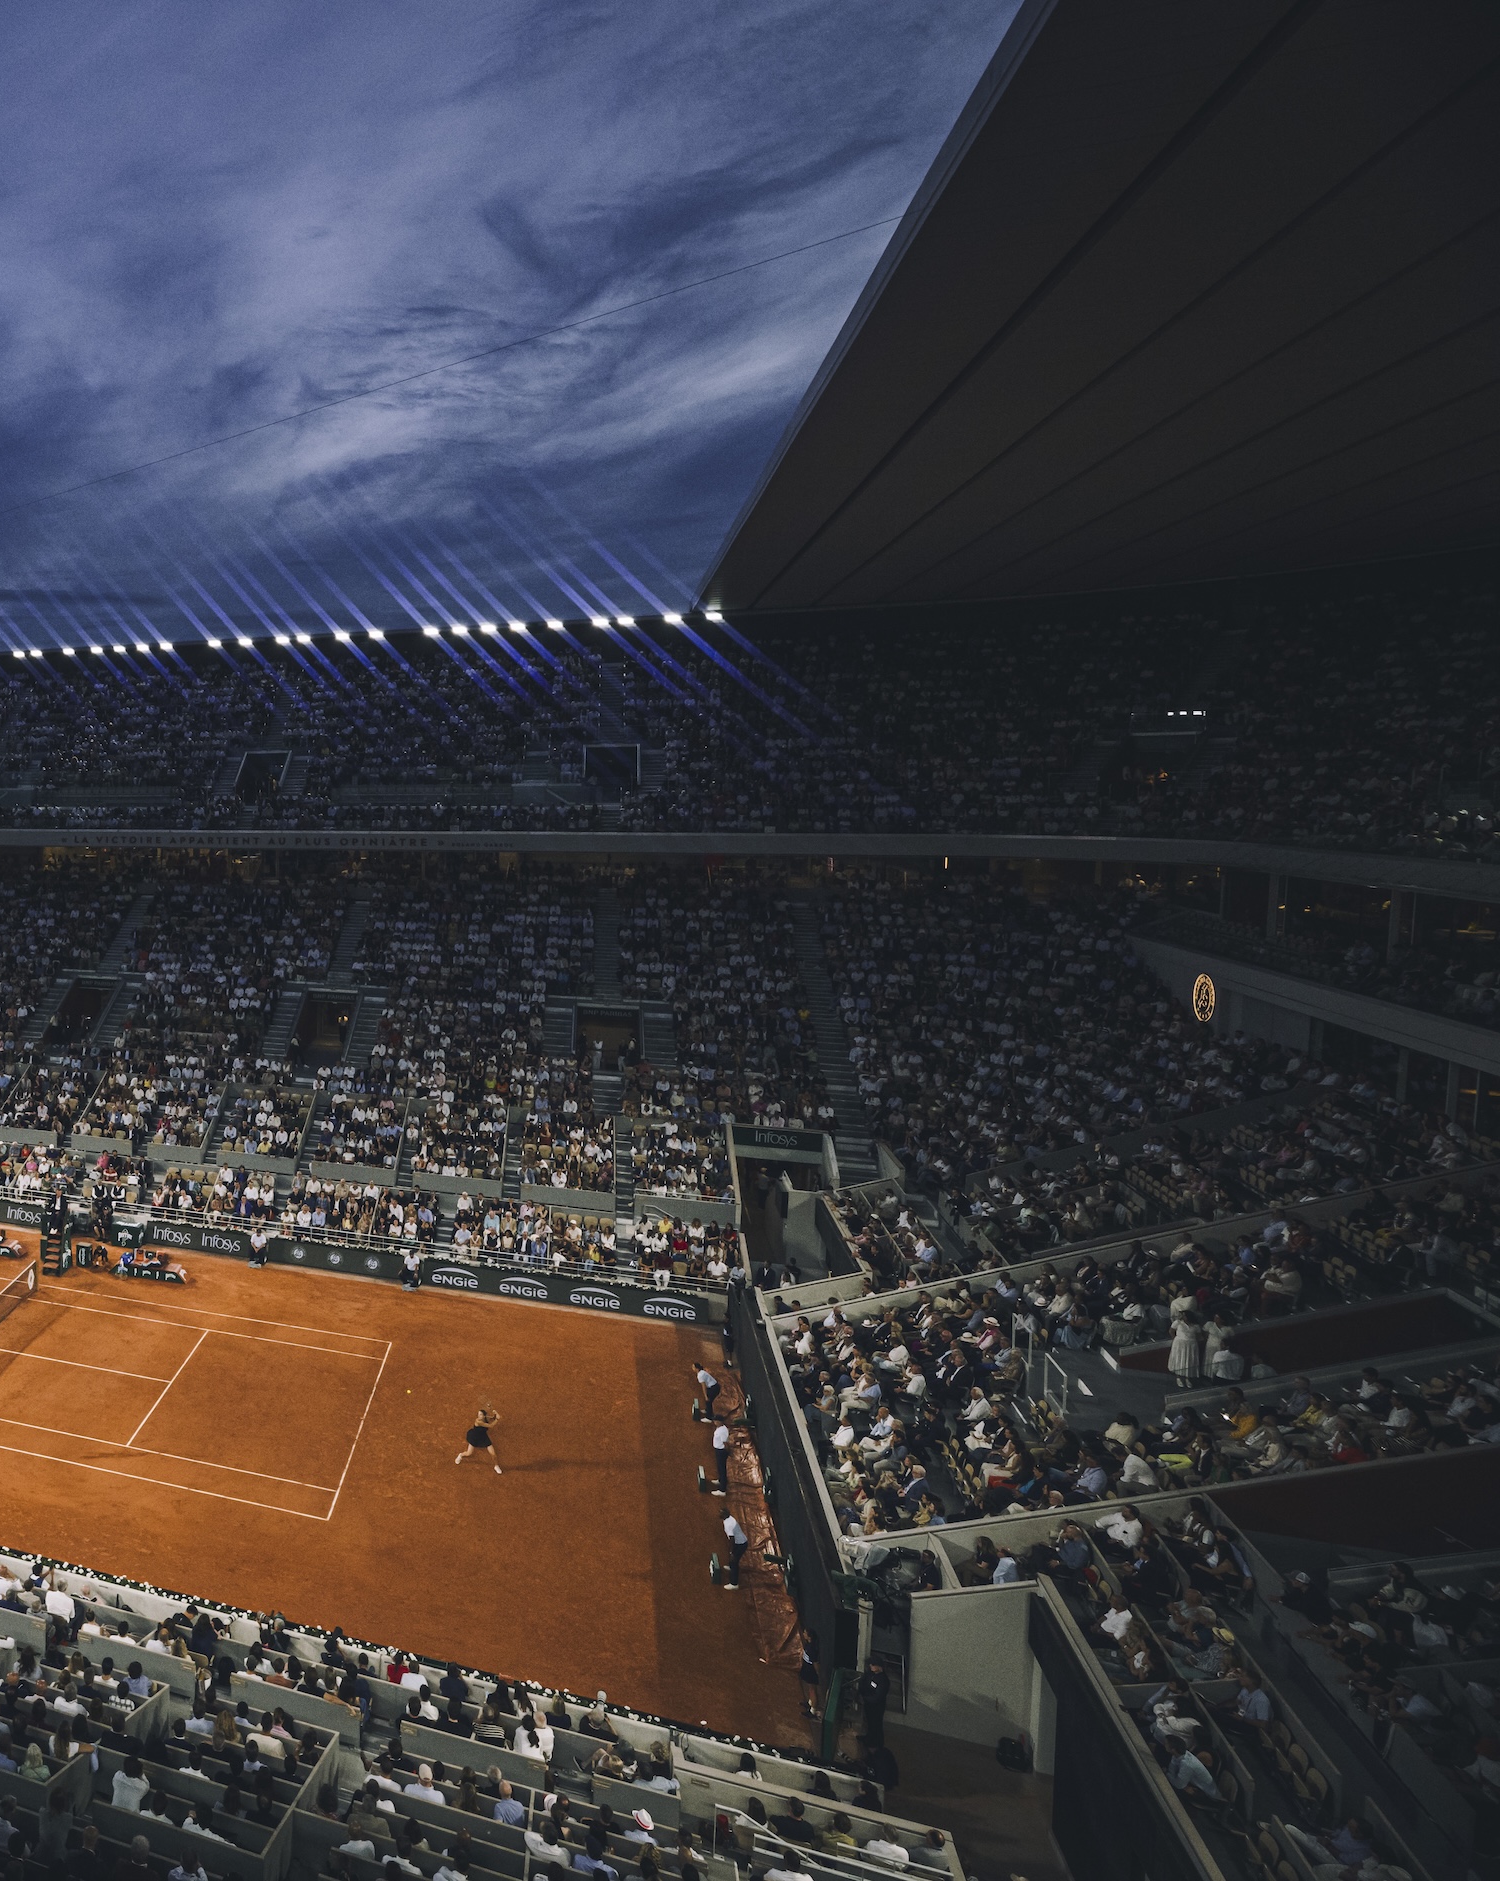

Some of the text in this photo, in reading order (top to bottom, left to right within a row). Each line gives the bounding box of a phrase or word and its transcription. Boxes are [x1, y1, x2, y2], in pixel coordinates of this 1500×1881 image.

[74, 836, 89, 844] LA
[95, 836, 161, 845] VICTOIRE
[169, 836, 260, 845] APPARTIENT
[268, 837, 286, 846] AU
[294, 837, 331, 846] PLUS
[339, 836, 428, 847] OPINIÂTRE
[600, 1010, 632, 1018] PARIBAS
[755, 1130, 798, 1147] Infosys
[7, 1205, 42, 1224] Infosys
[153, 1225, 191, 1245] Infosys
[201, 1232, 241, 1253] Infosys
